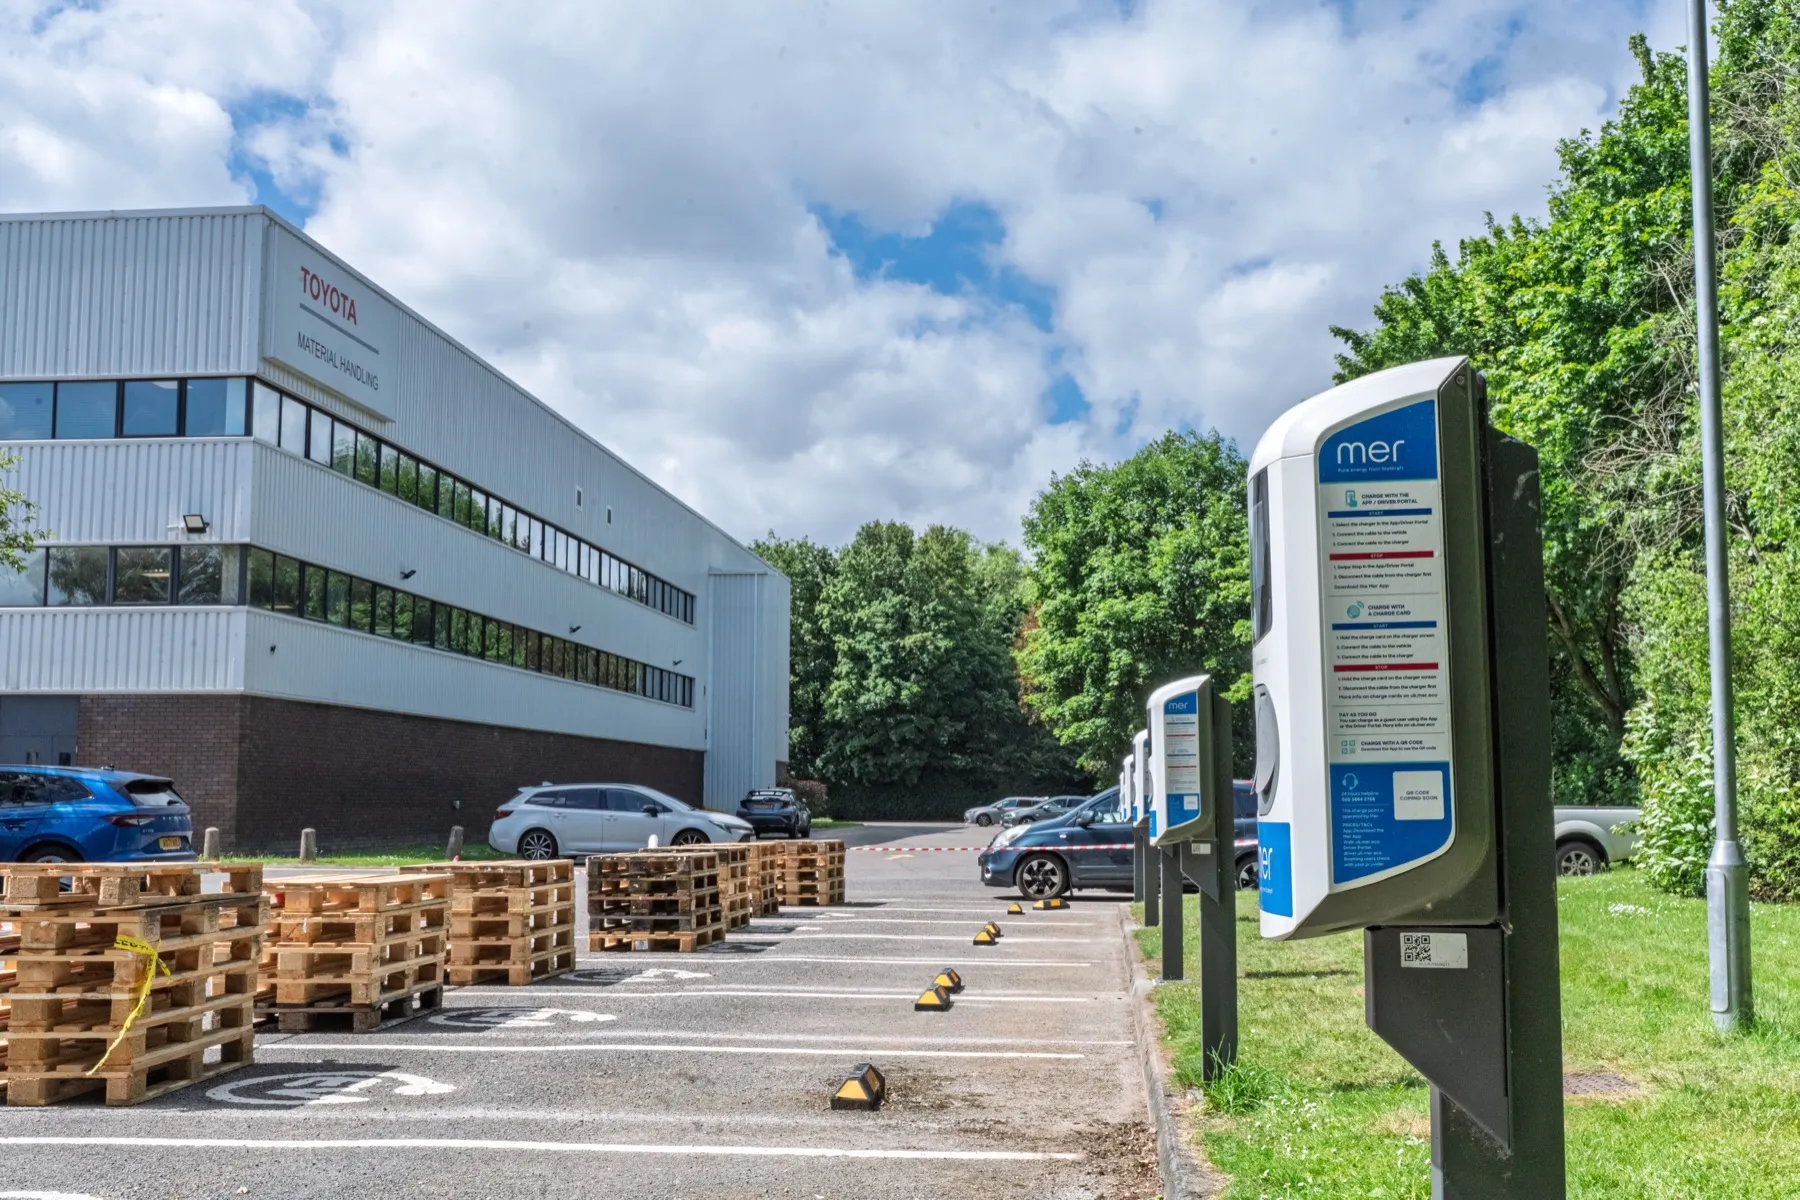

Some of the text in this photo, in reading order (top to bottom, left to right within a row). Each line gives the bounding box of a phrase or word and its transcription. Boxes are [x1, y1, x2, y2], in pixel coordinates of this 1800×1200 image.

[301, 266, 357, 325] TOYOTA
[298, 332, 378, 390] MATERIAL HANDLING
[1337, 440, 1404, 464] mer
